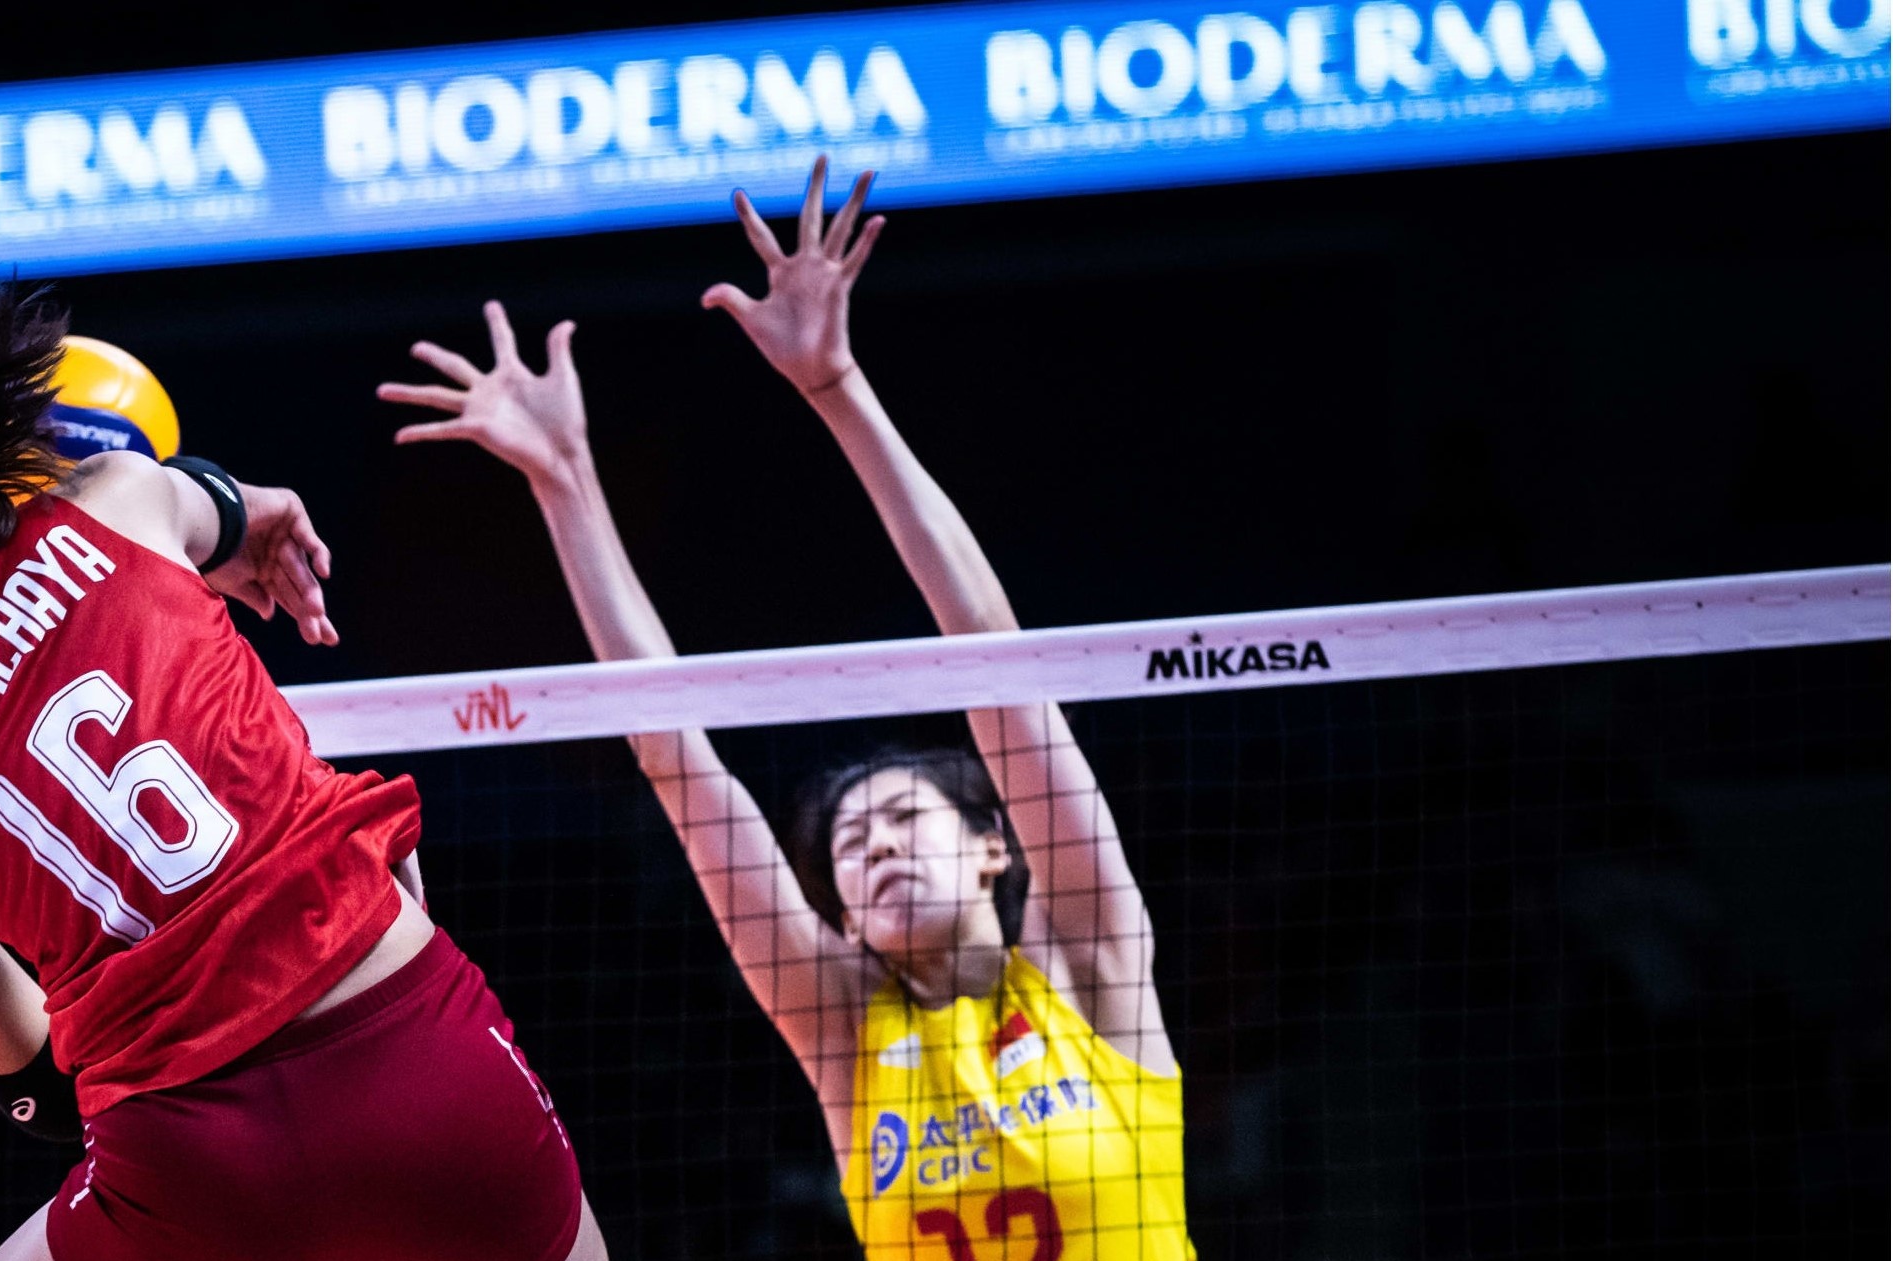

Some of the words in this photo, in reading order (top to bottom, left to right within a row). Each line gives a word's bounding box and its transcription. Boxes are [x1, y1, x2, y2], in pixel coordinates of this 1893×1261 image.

[323, 44, 928, 181] BIODERMA
[985, 0, 1607, 126] BIODERMA
[1688, 0, 1893, 69] BIO
[1145, 632, 1330, 681] MIKASA
[454, 682, 527, 734] VNL
[918, 1145, 992, 1186] CPIC
